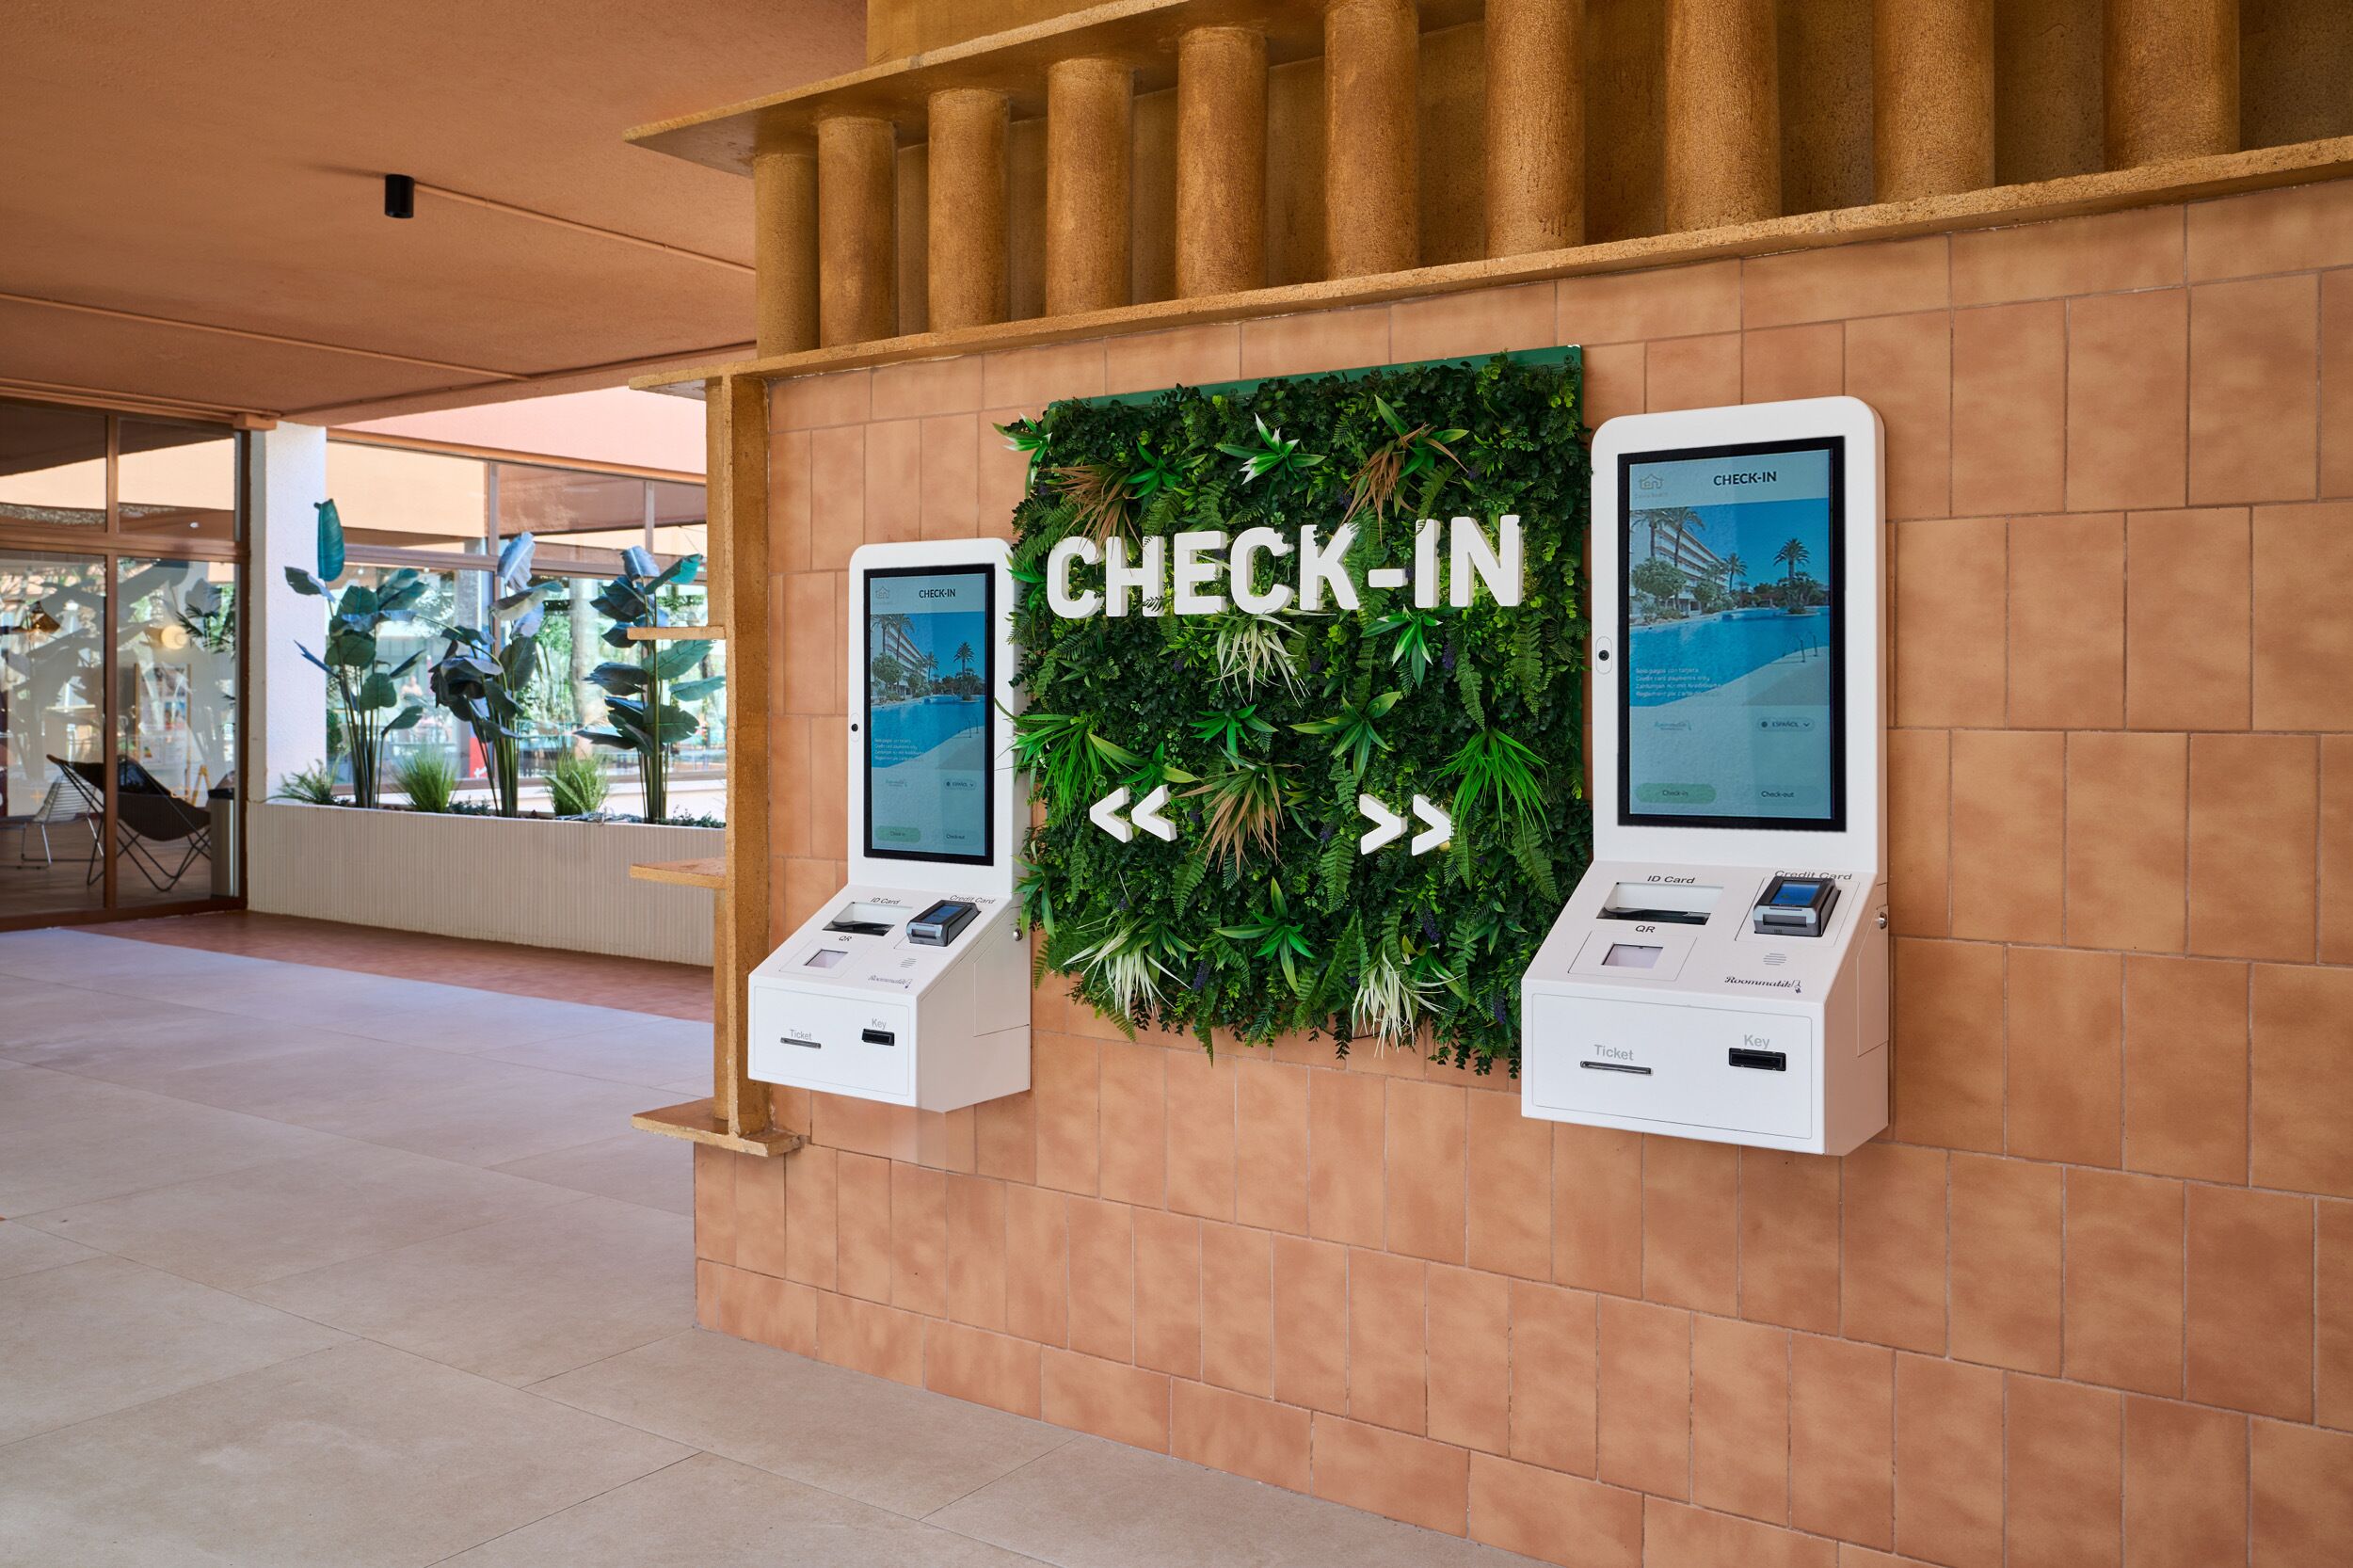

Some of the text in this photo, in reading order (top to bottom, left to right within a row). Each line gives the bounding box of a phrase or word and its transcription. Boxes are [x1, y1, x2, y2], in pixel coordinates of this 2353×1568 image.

[1713, 471, 1777, 486] CHECK-IN
[1047, 514, 1523, 618] CHECK-IN
[919, 588, 956, 599] CHECK-IN
[1662, 789, 1689, 797] Check-in
[1761, 790, 1794, 798] Check-out
[1774, 870, 1852, 880] Credit Card
[950, 894, 973, 903] Credit
[872, 1017, 887, 1031] Key
[790, 1029, 812, 1041] Ticket
[1743, 1033, 1770, 1049] Key
[1593, 1044, 1634, 1062] Ticket
